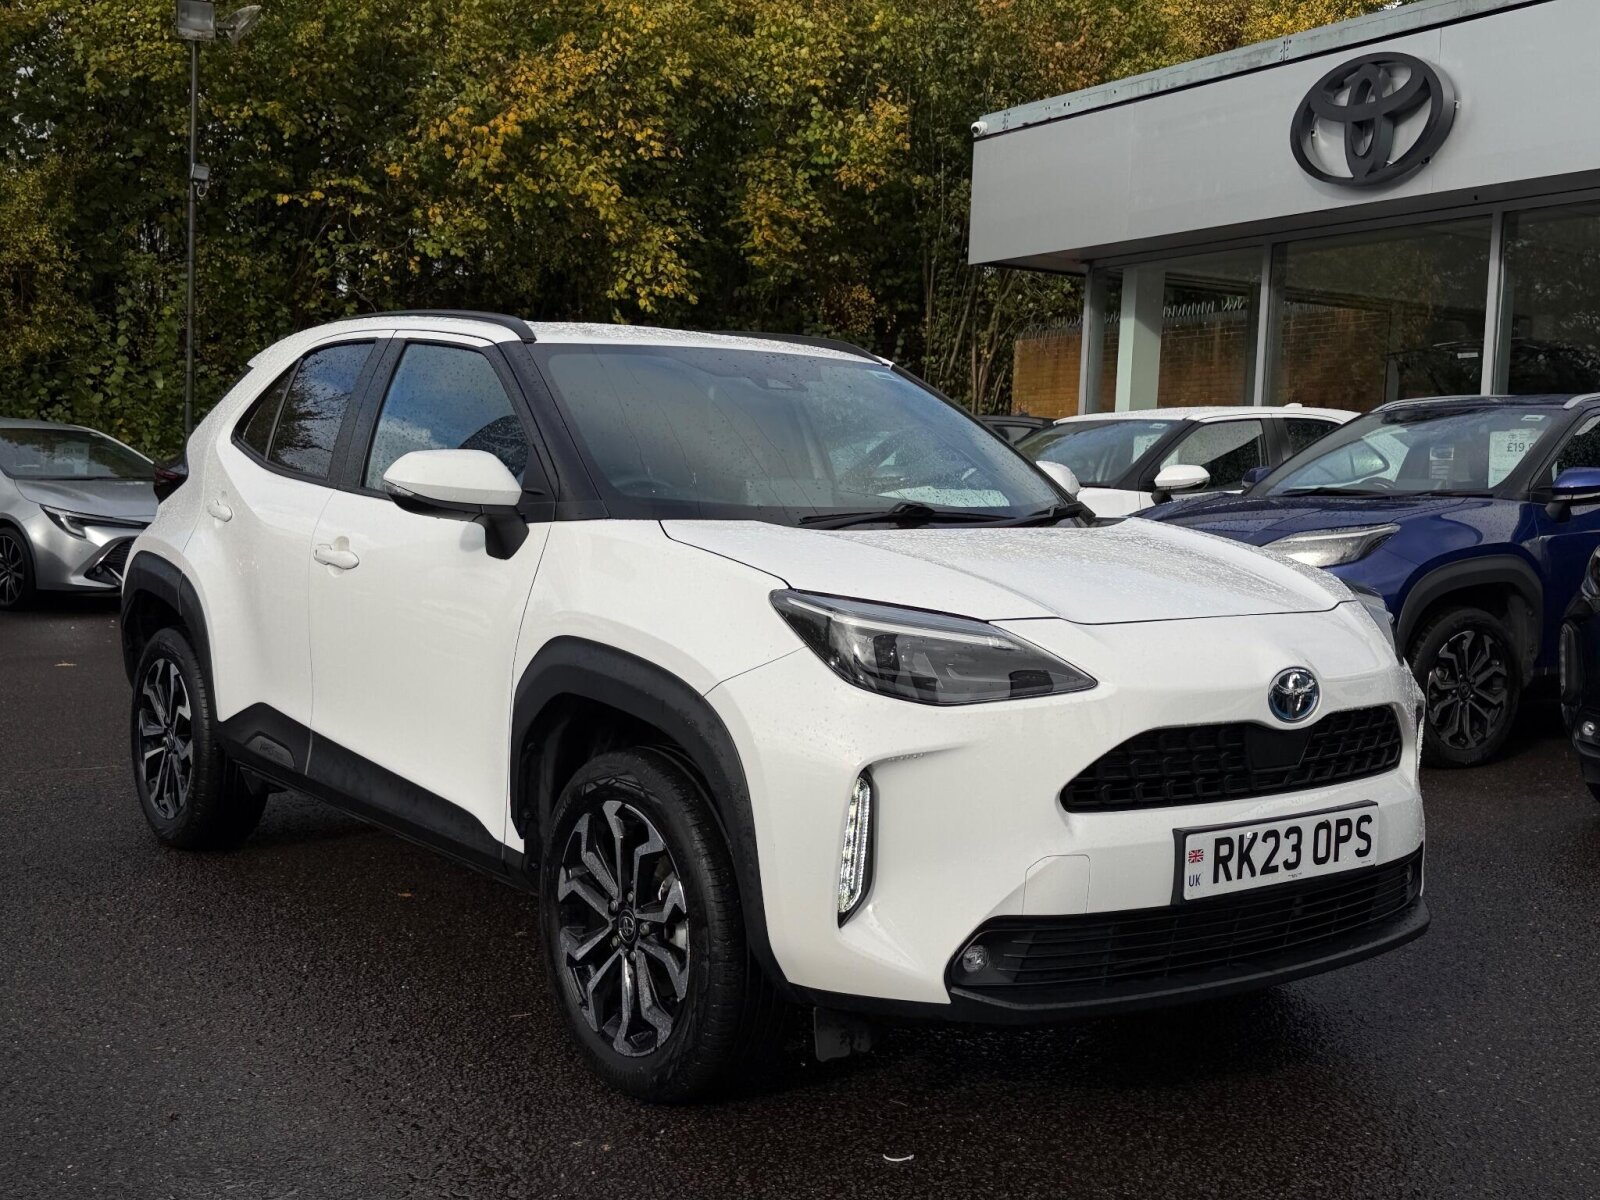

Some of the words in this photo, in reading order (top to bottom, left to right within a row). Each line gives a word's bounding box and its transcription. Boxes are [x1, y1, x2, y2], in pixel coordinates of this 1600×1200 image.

[1213, 826, 1302, 884] RK23
[1312, 814, 1373, 866] OPS
[1188, 873, 1201, 887] UK
